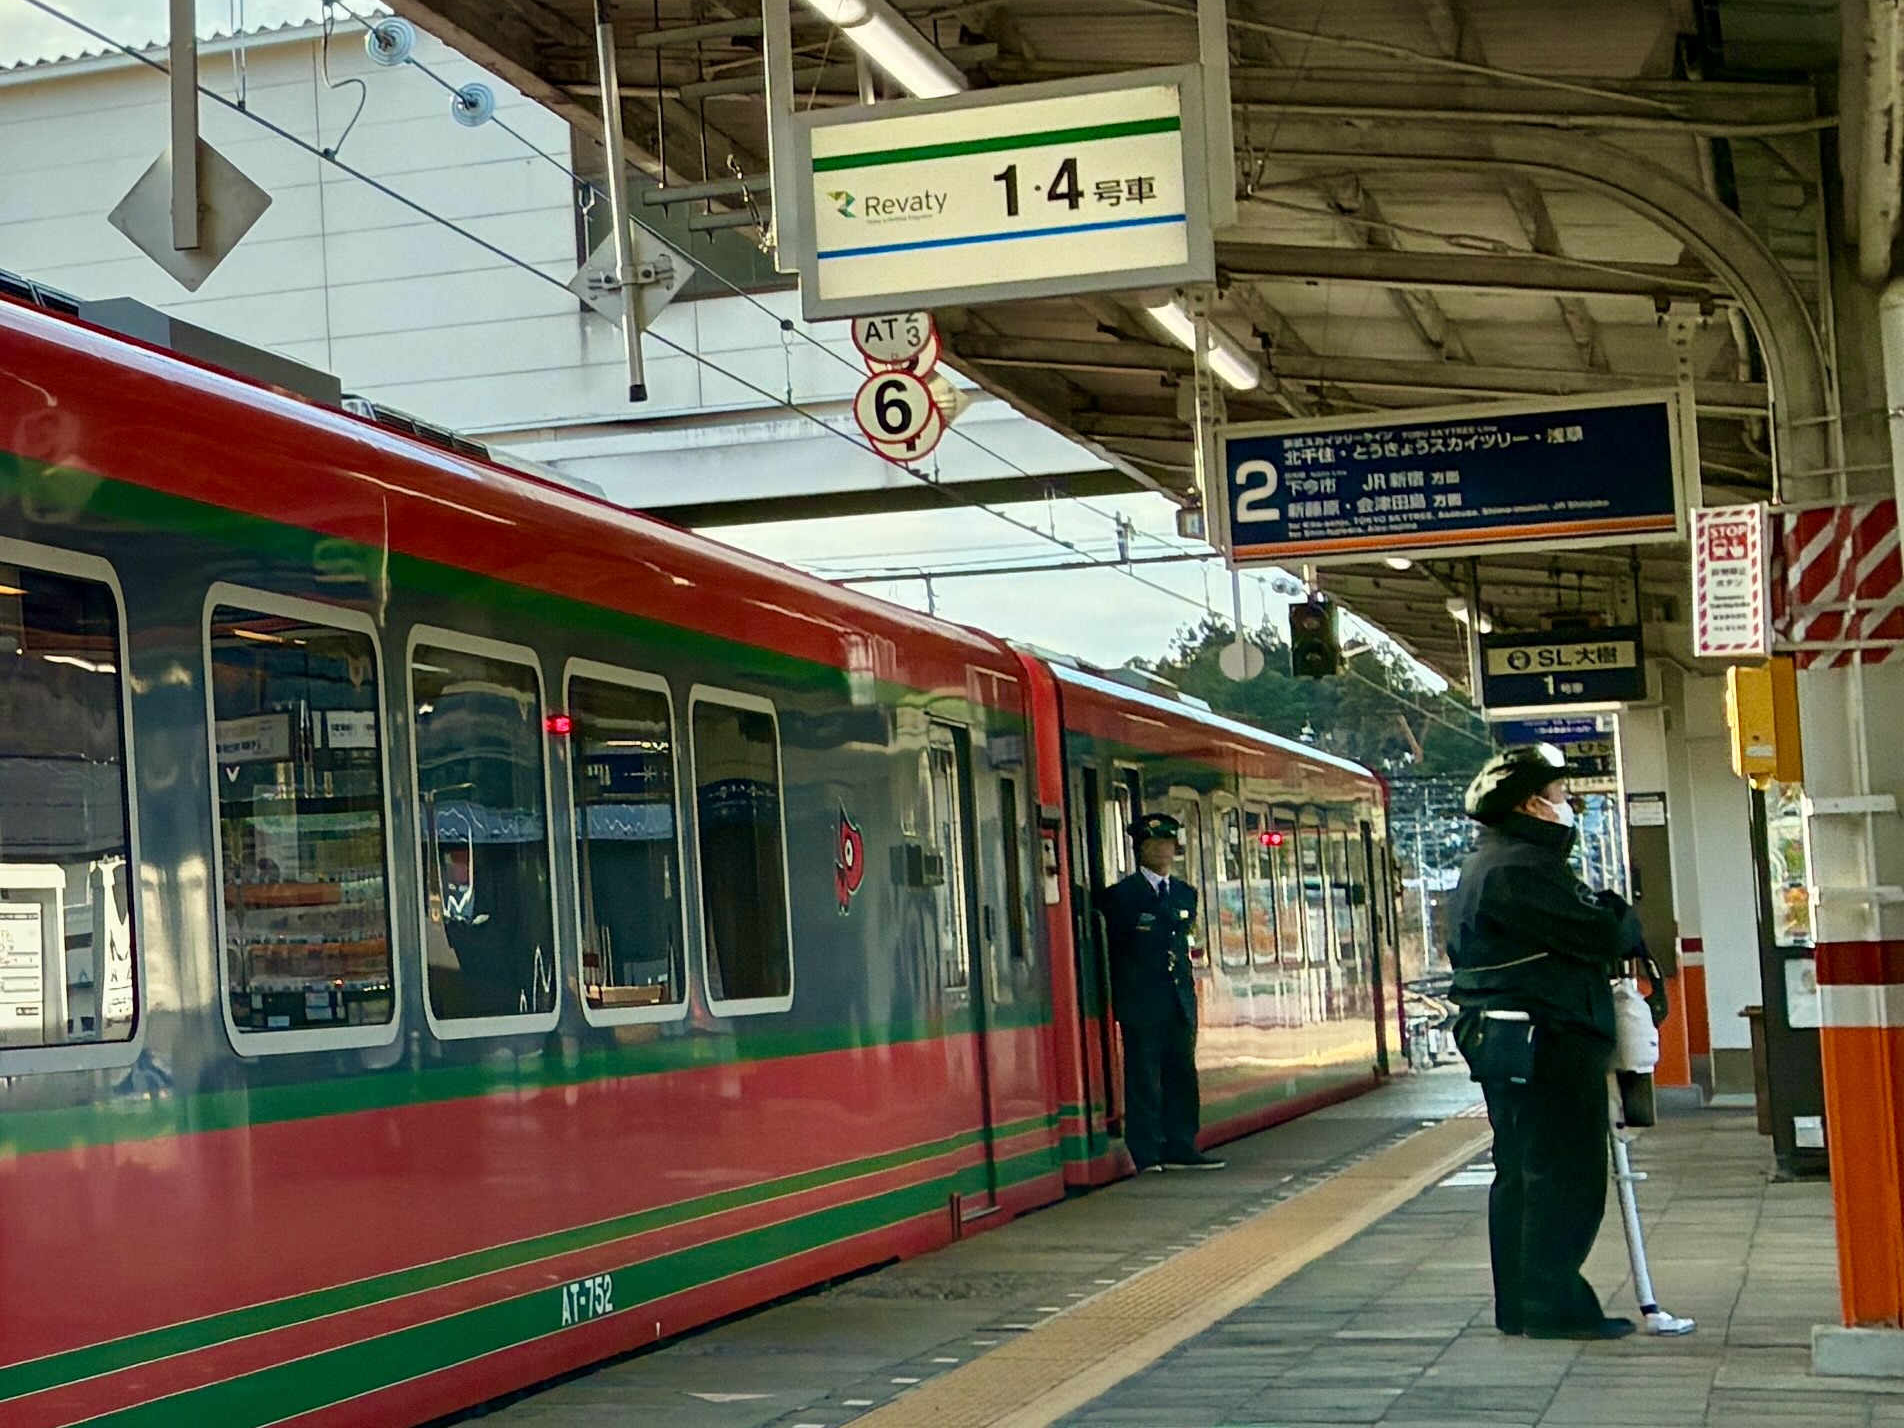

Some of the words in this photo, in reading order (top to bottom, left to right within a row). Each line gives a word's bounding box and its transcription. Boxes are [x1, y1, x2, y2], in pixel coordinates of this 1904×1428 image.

[866, 189, 947, 219] Revaty
[865, 318, 898, 343] AT
[906, 326, 921, 347] 3
[875, 380, 912, 435] 6
[1235, 460, 1280, 522] 2
[1710, 525, 1747, 538] STOP
[562, 1274, 614, 1326] AT-752
